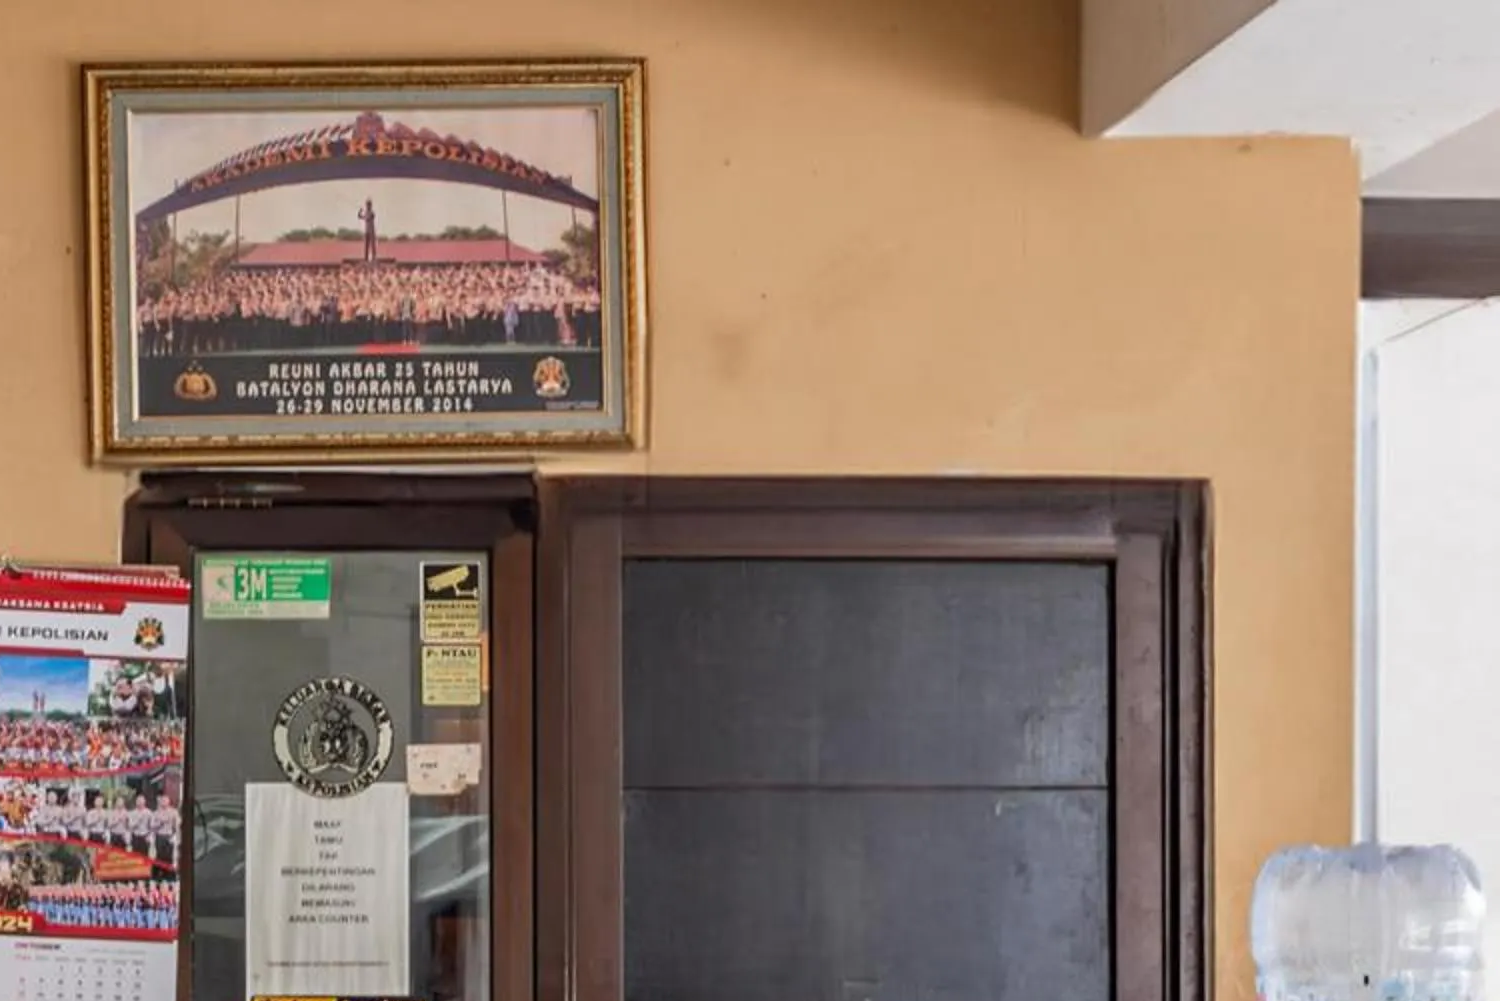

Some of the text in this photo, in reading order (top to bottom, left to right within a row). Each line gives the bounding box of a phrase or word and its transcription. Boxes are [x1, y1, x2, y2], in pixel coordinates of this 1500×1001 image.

[268, 361, 479, 379] REUNI AKBAR 25 TAHUN
[236, 378, 513, 398] BATALYON DHARANA LASTARYA
[276, 397, 474, 415] 26-29 NOVEMBER 2014
[237, 568, 267, 600] 3M
[7, 625, 110, 642] KEPOLISIAN
